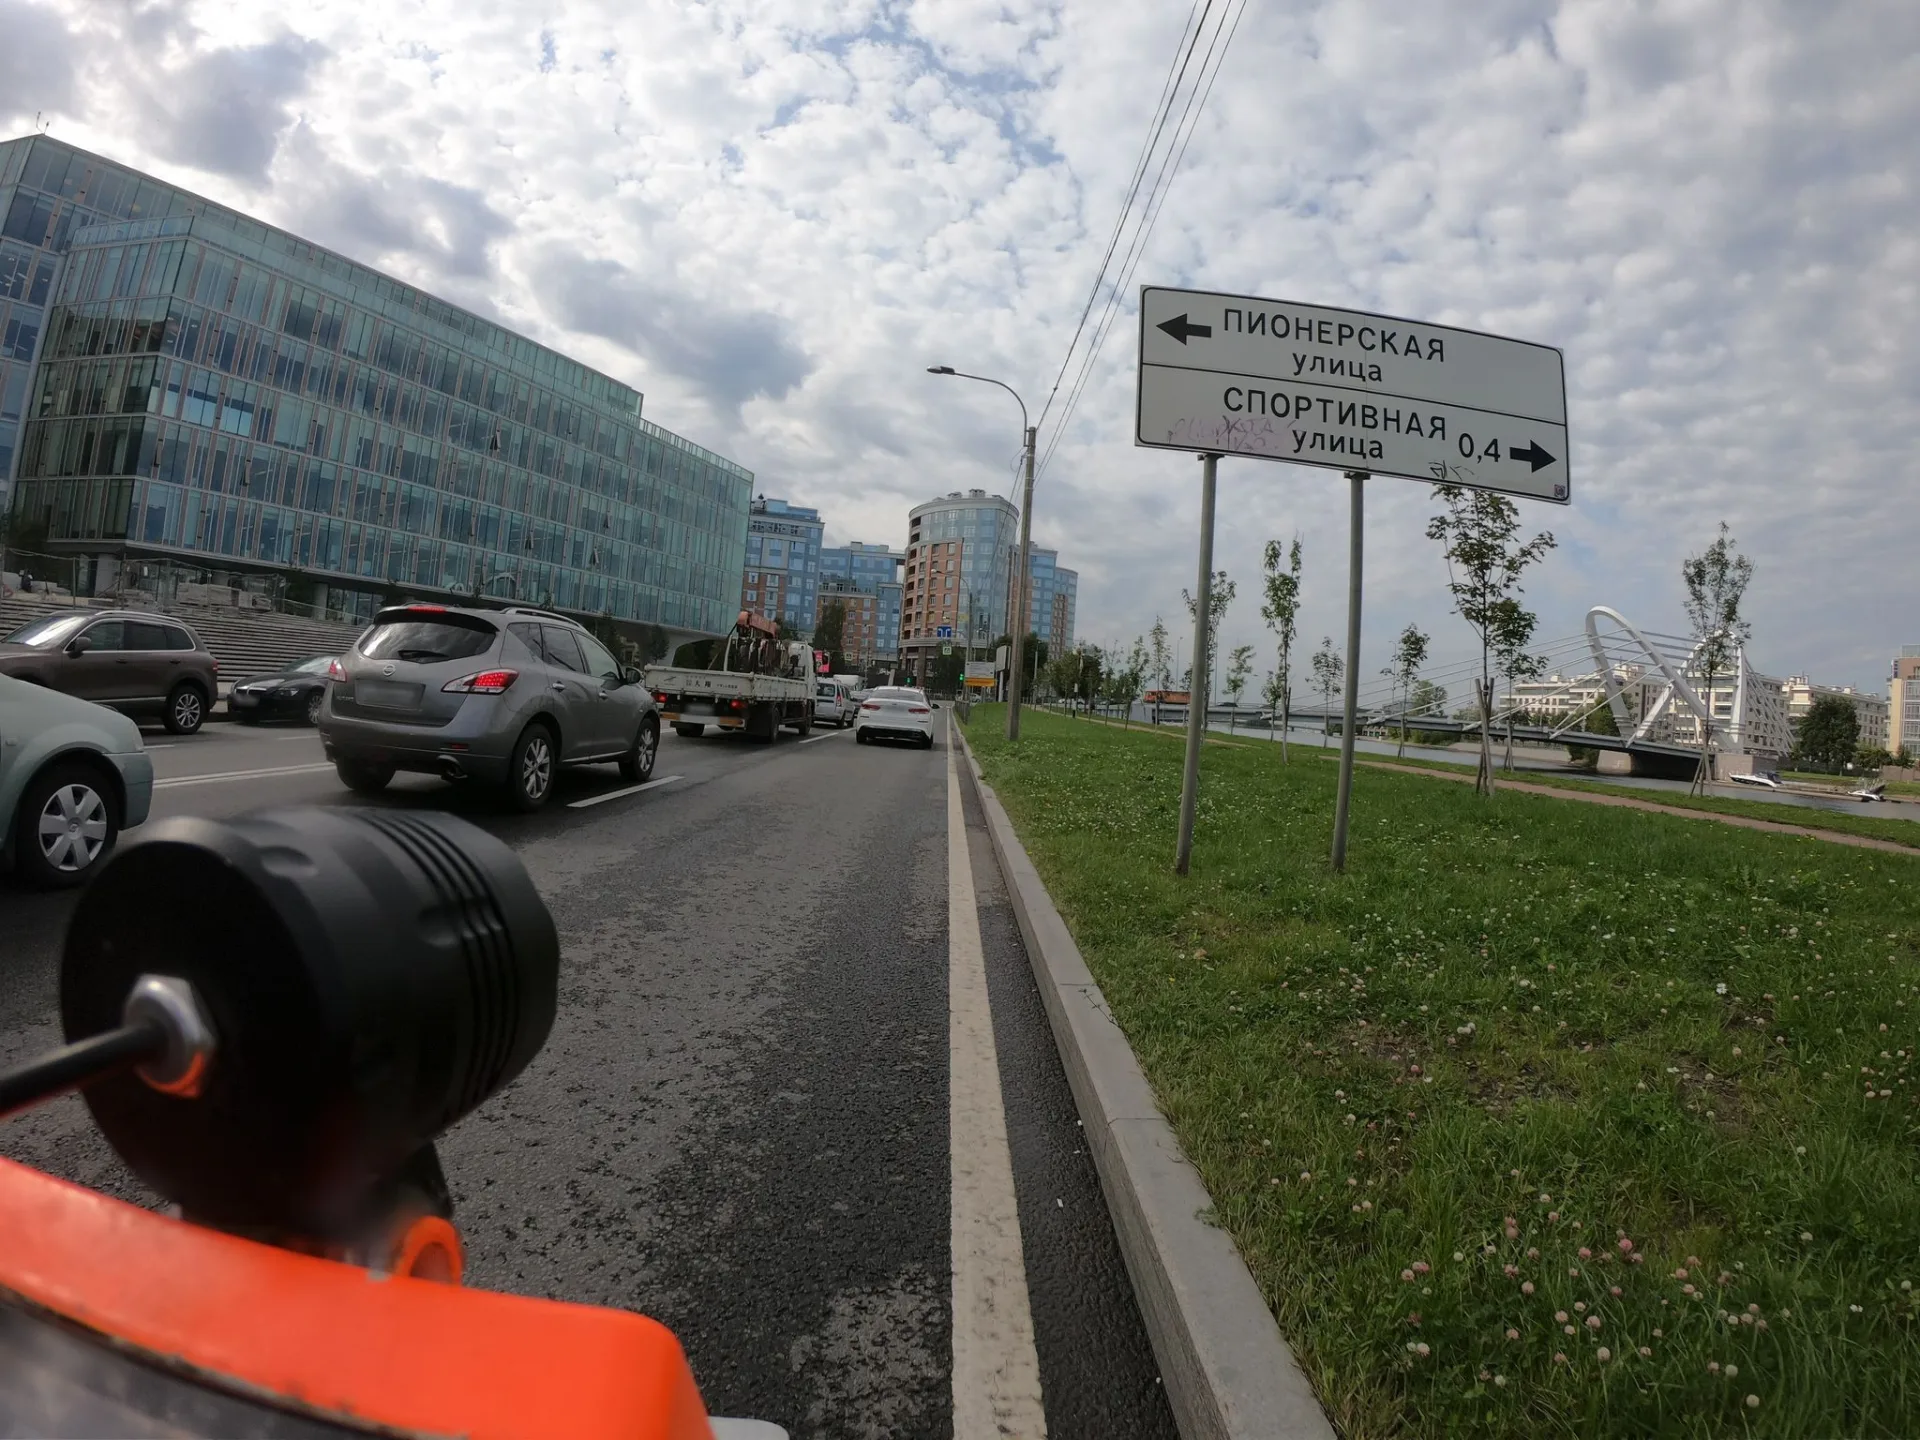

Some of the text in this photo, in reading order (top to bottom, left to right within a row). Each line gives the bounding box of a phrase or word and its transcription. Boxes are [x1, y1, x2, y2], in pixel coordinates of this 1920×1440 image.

[1223, 309, 1445, 362] ПИОНЕРСКАЯ
[1292, 353, 1383, 383] улица
[1223, 387, 1446, 441] СПОРТИВНАЯ
[1292, 429, 1384, 460] улица
[1458, 433, 1501, 463] 0,4
